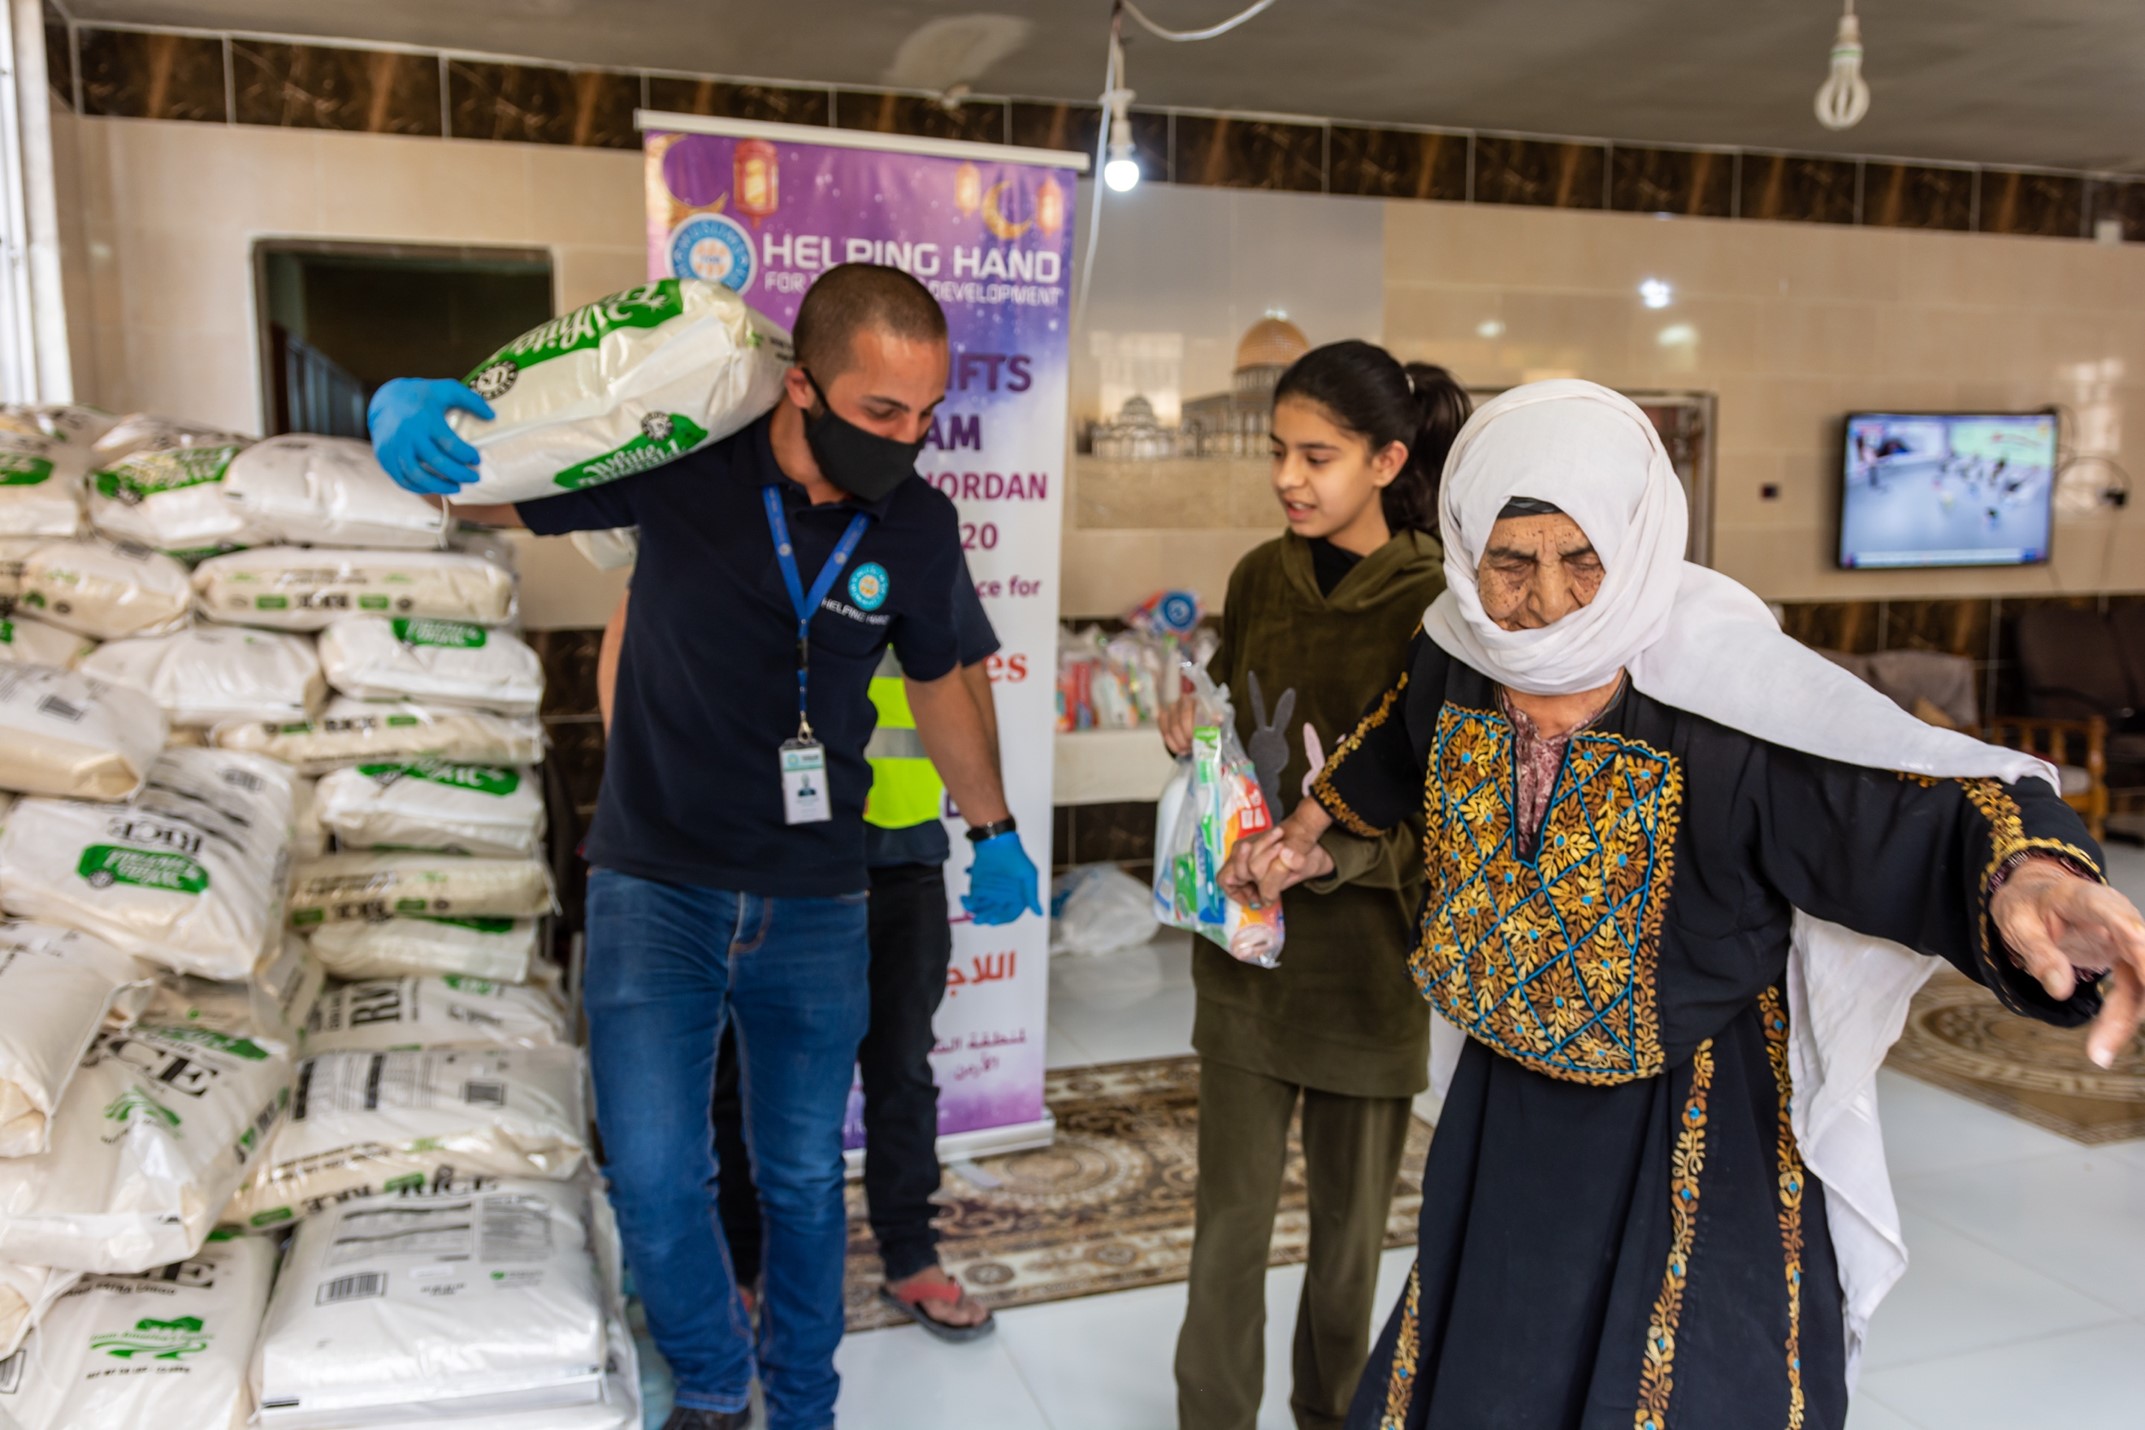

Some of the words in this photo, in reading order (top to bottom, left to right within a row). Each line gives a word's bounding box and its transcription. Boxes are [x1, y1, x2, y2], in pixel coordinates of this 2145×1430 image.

[763, 232, 941, 277] HELPING
[953, 244, 1061, 283] HAND
[764, 270, 806, 293] FOR
[928, 279, 1064, 306] DEVELOPMENT
[1009, 575, 1041, 597] for
